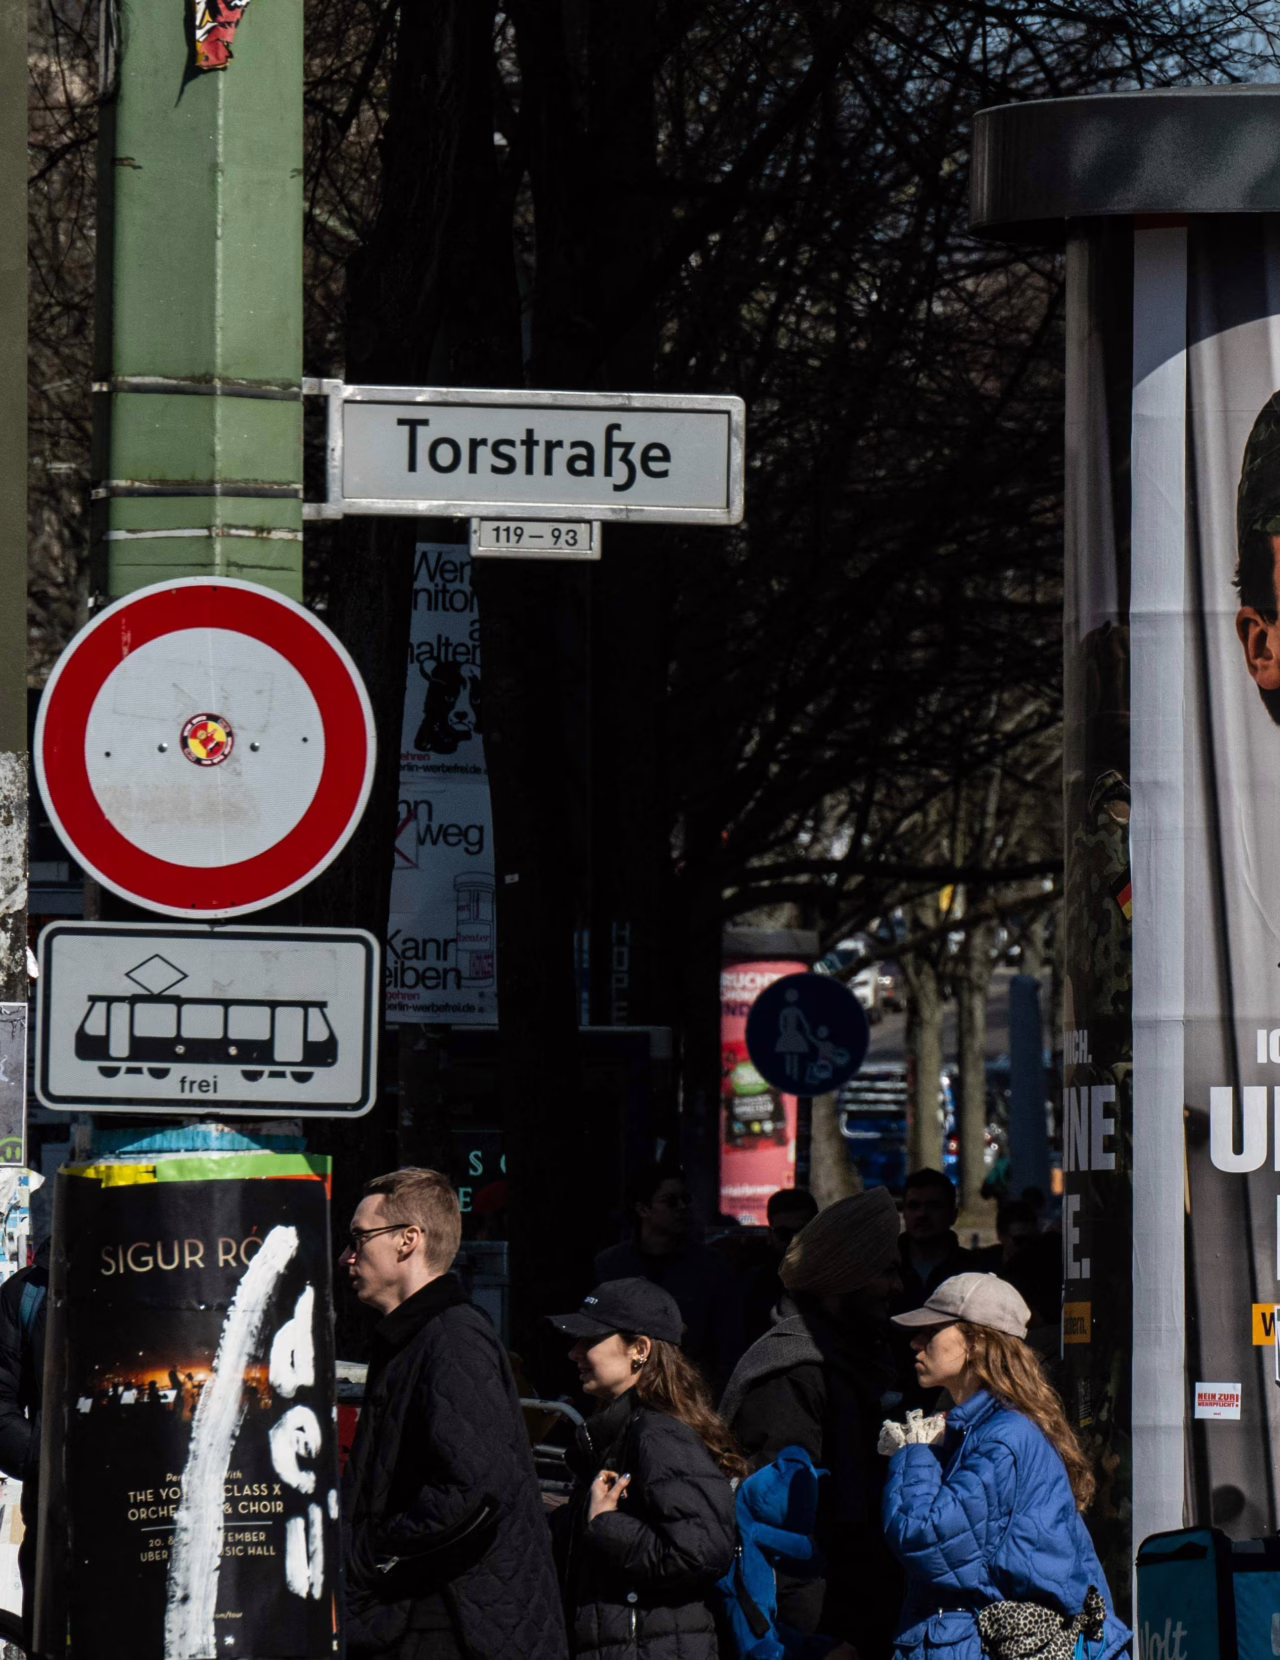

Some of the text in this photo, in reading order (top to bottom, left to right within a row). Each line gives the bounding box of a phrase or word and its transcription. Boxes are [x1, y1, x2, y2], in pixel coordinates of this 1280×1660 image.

[397, 418, 672, 493] Torstraße
[491, 525, 525, 545] 119
[550, 528, 578, 547] 93
[180, 1075, 218, 1094] frei
[100, 1238, 205, 1276] SIGUR
[128, 1489, 155, 1504] THE
[273, 1483, 283, 1496] X
[238, 1501, 285, 1514] CHOIR
[140, 1549, 169, 1563] UBER
[247, 1544, 277, 1556] HALL
